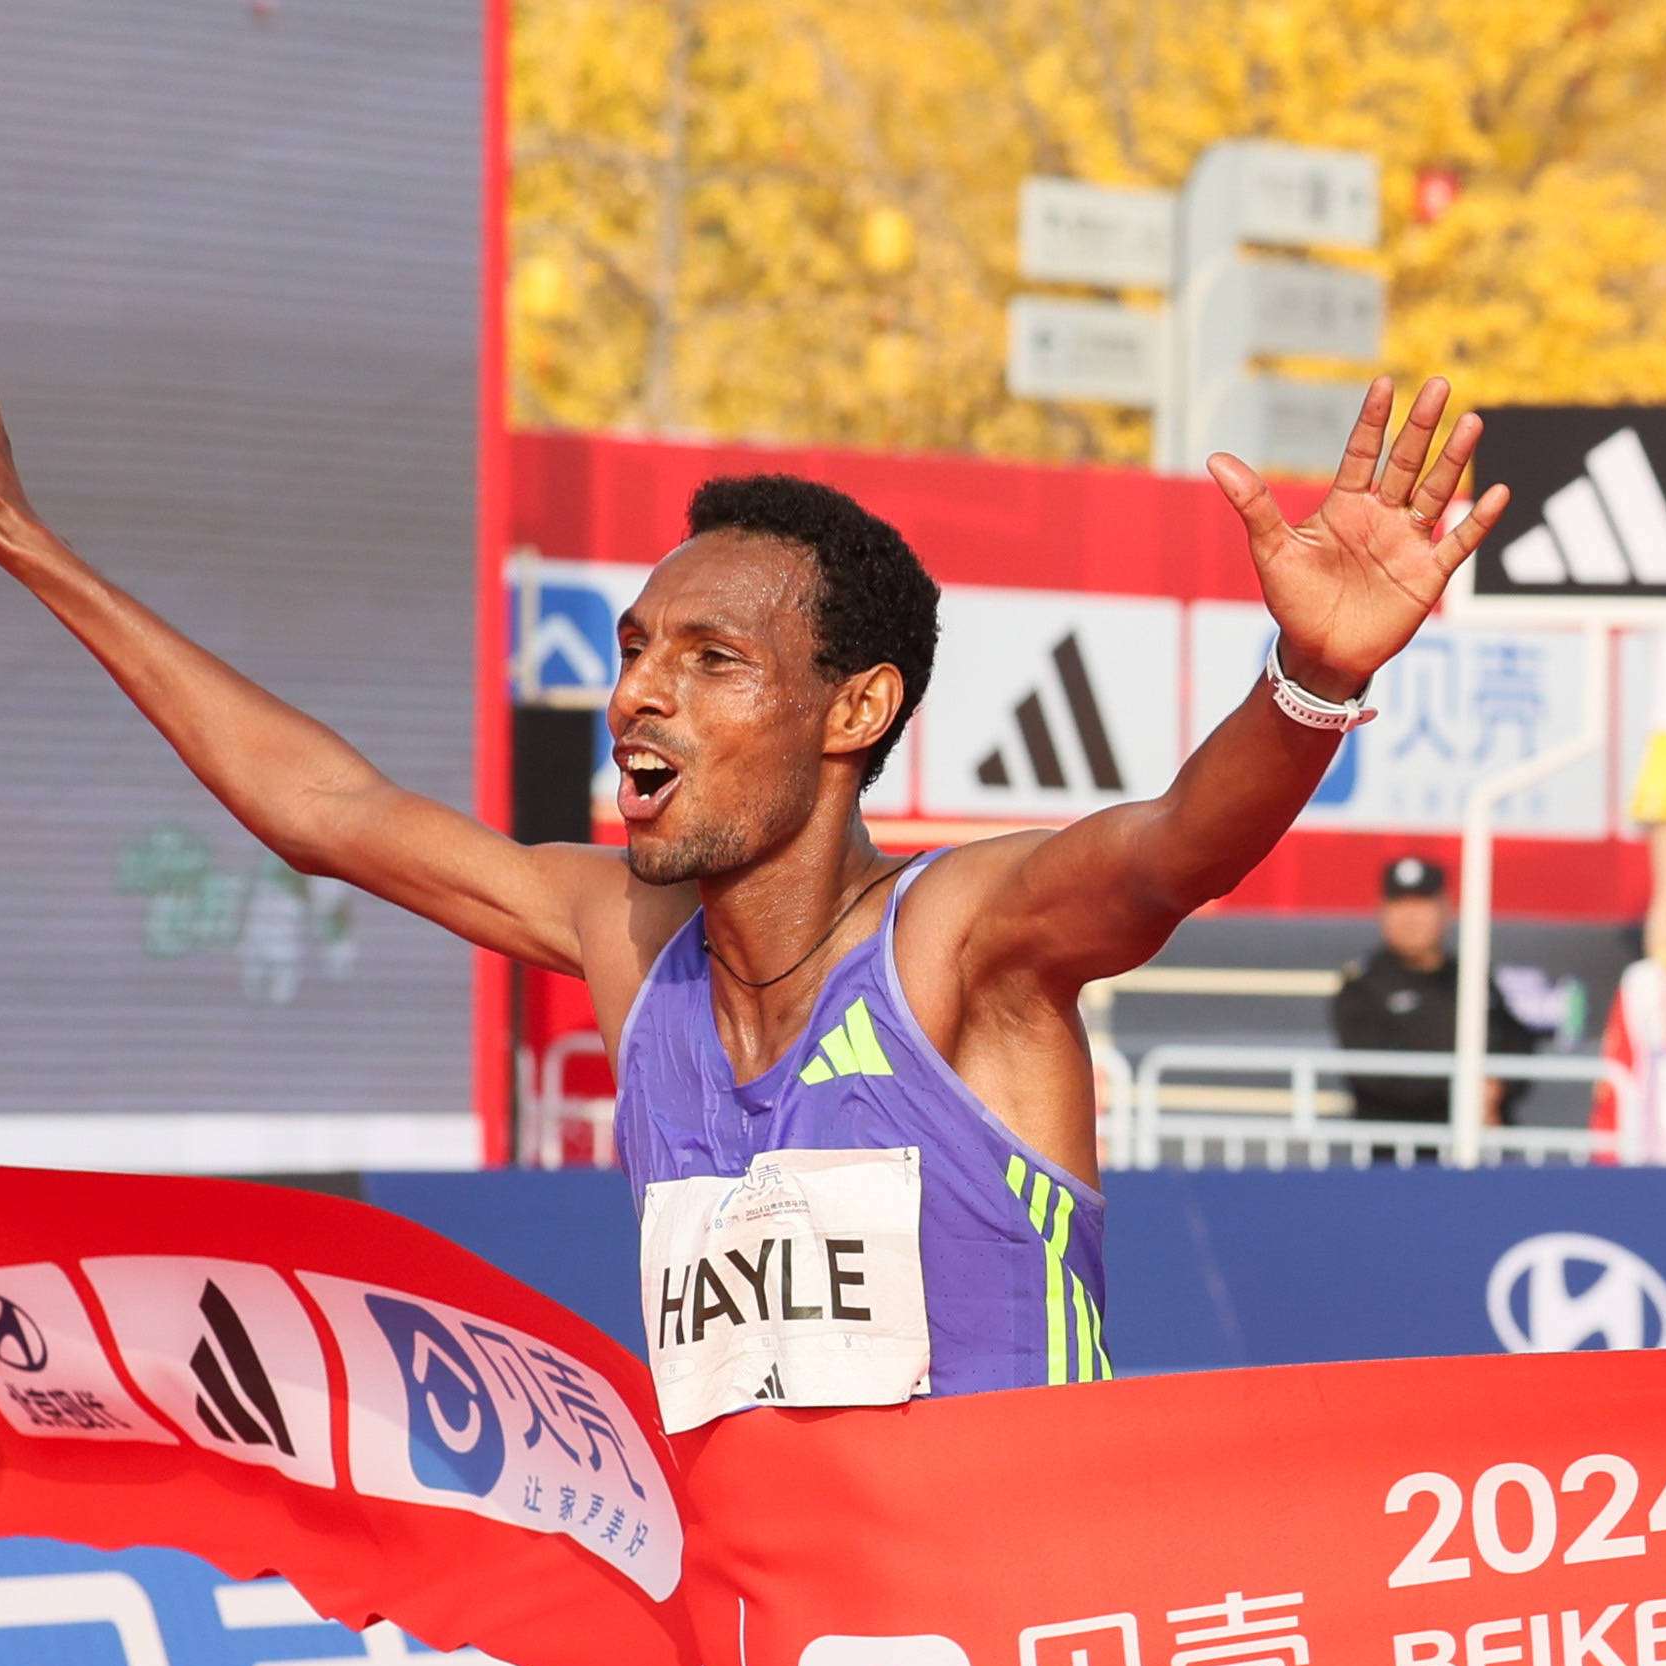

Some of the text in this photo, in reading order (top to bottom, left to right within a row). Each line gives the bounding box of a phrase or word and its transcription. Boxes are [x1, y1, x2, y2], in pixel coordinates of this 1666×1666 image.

[1387, 636, 1547, 762] 贝壳
[659, 1238, 872, 1350] HAYLE
[461, 1321, 647, 1500] 贝壳
[522, 1475, 649, 1559] 让家更美好
